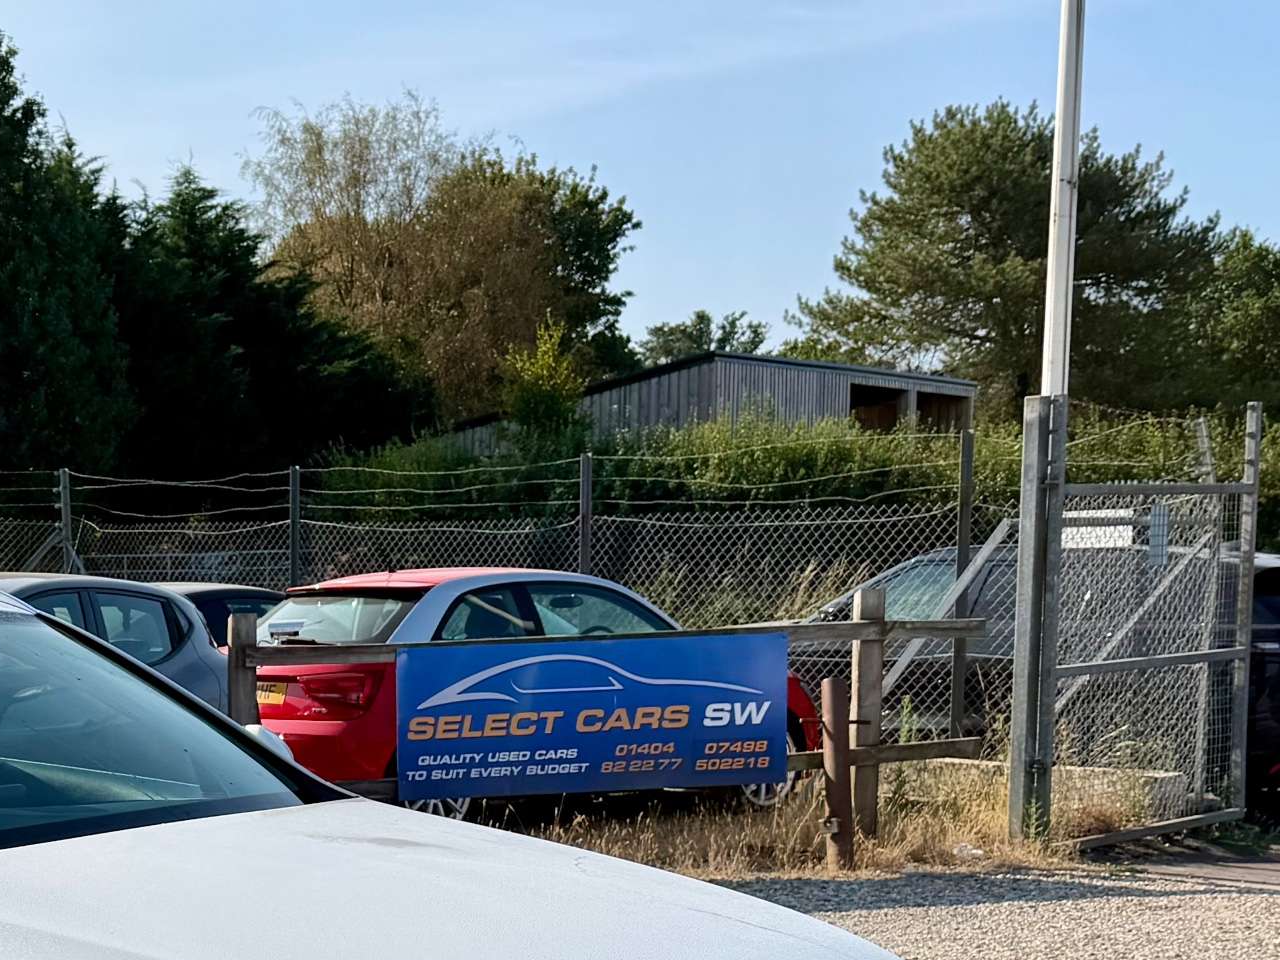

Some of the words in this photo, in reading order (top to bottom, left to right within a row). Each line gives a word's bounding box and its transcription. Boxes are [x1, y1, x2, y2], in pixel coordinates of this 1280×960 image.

[407, 710, 564, 741] SELECT
[575, 704, 690, 733] CARS
[703, 701, 772, 727] SW
[615, 741, 675, 756] 01404
[704, 740, 768, 755] 07498
[417, 752, 484, 766] QUALITY
[487, 750, 530, 763] USED
[534, 748, 578, 760] CARS
[406, 770, 427, 781] TO
[431, 768, 467, 780] SUIT
[470, 765, 522, 779] EVERY
[525, 762, 590, 776] BUDGET
